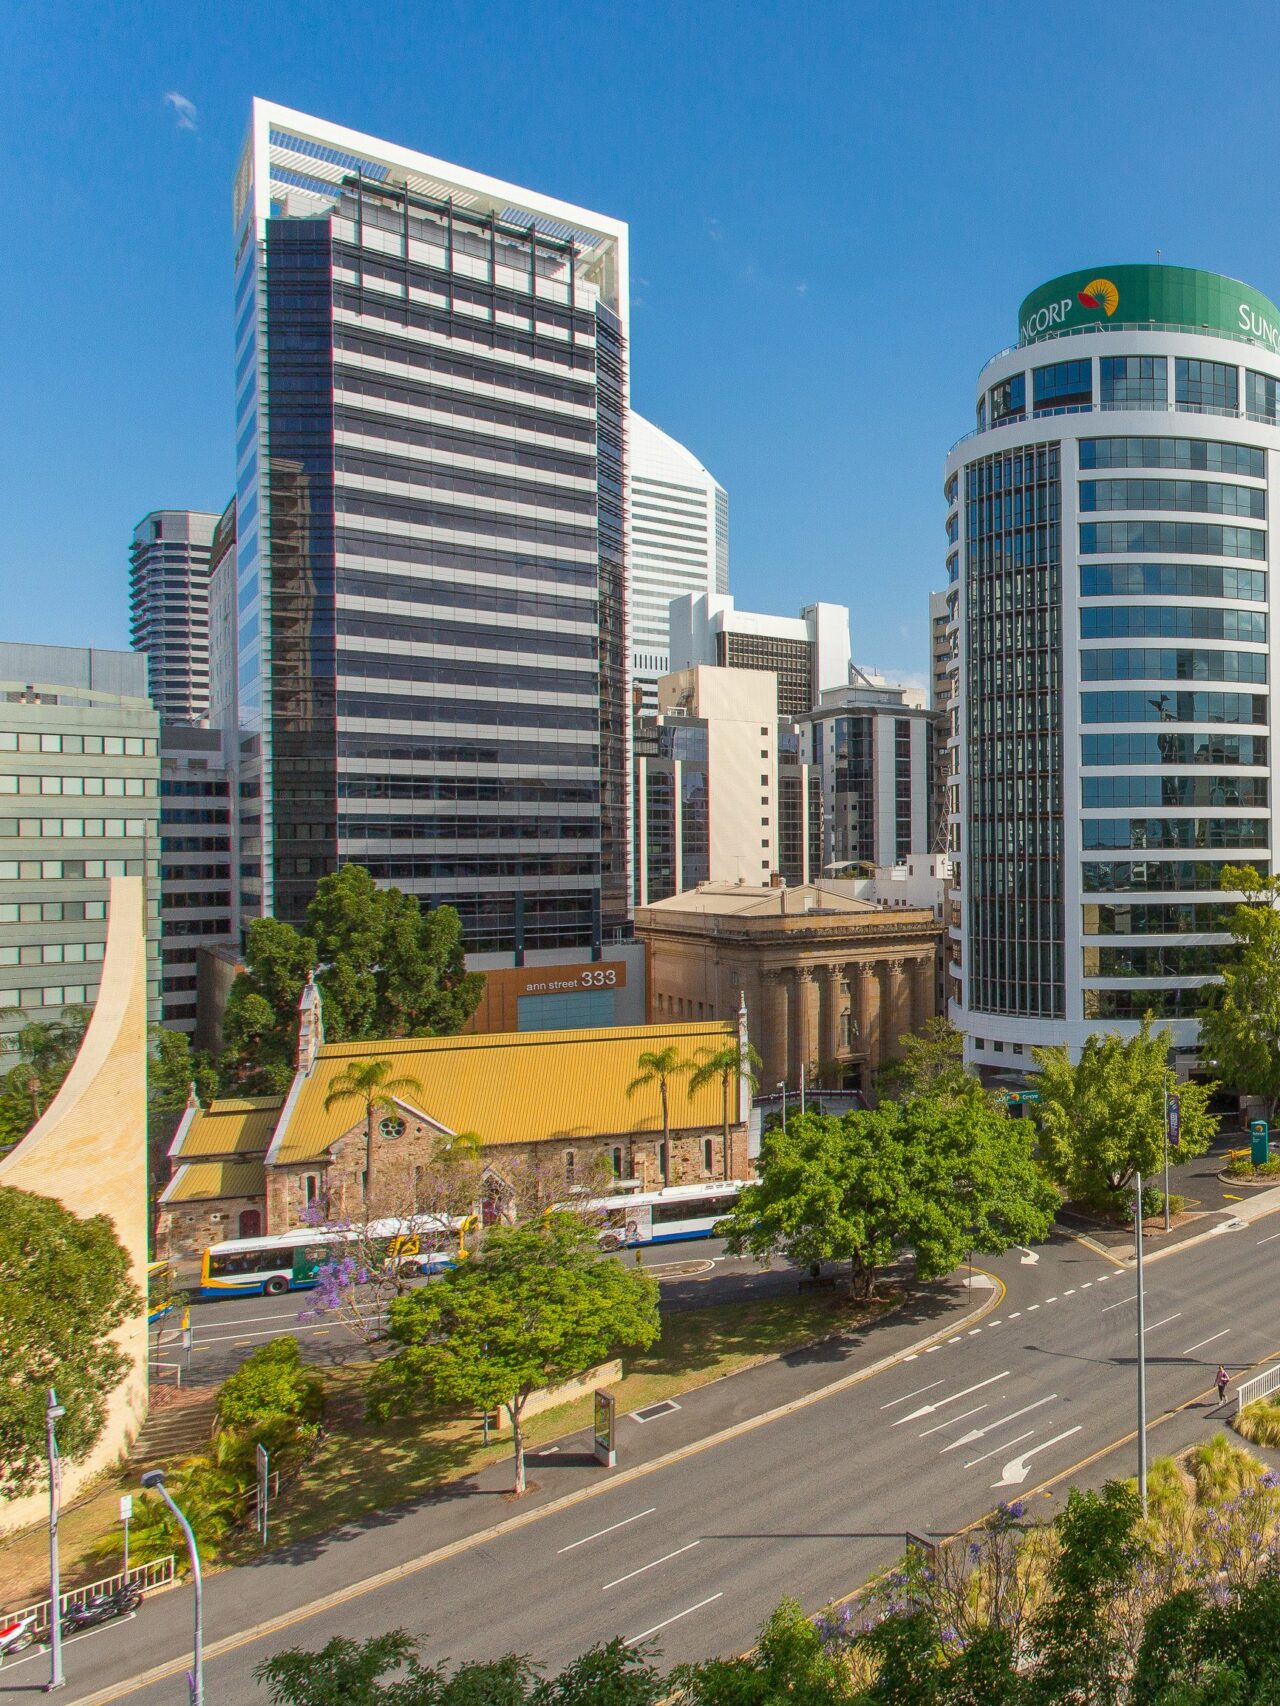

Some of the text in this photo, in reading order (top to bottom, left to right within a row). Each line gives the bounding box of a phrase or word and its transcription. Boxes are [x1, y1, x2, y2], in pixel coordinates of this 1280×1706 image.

[1021, 298, 1073, 344] NCORP
[526, 969, 616, 991] ann street 333
